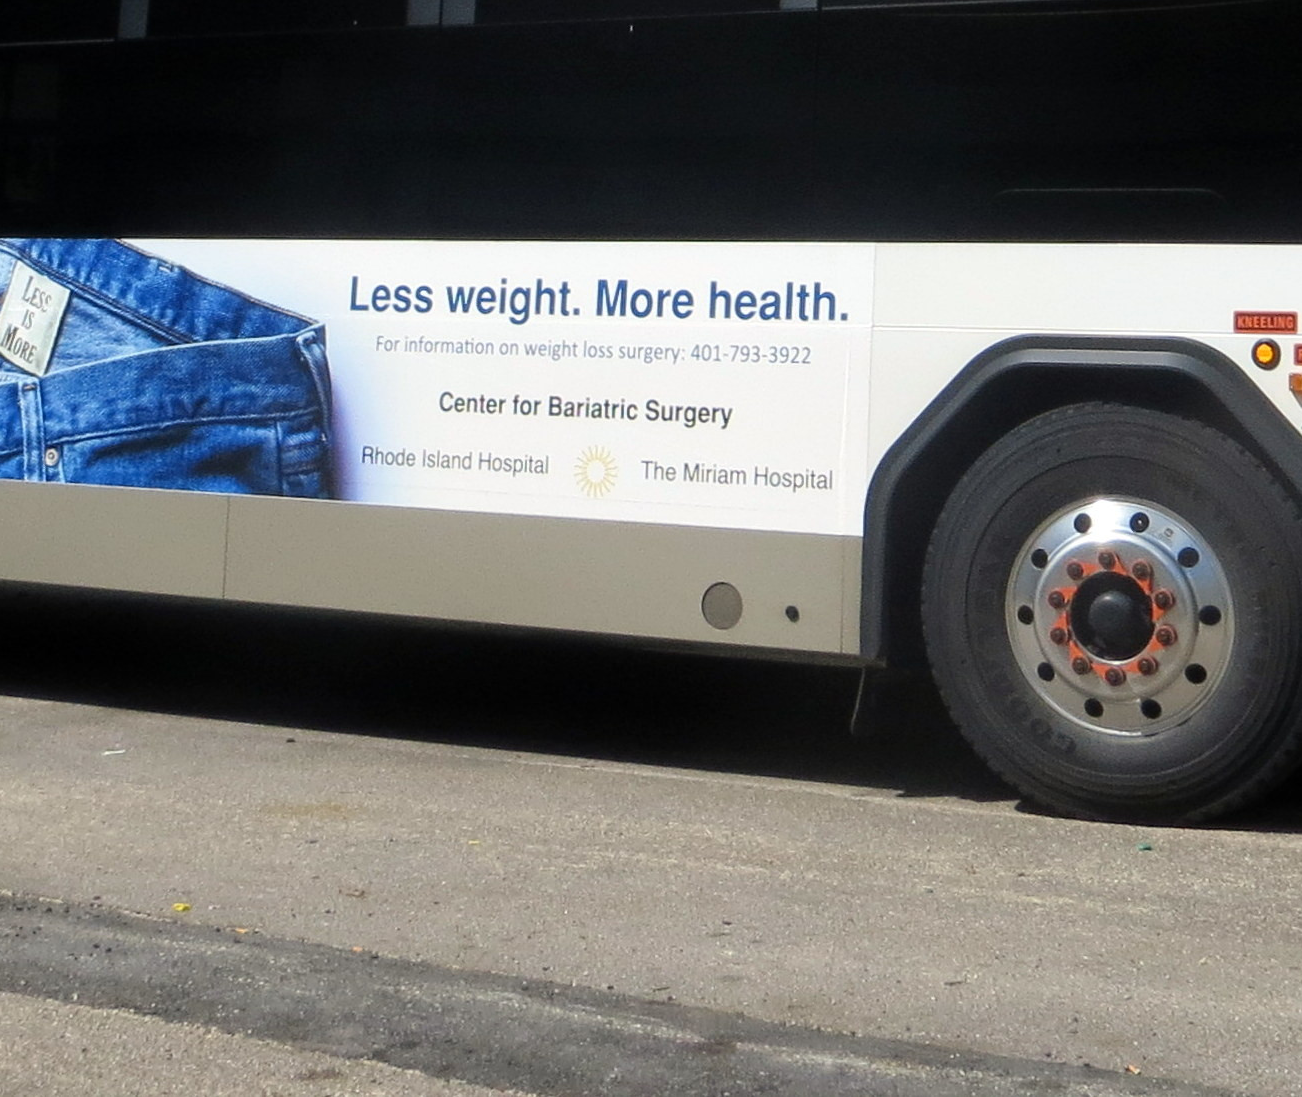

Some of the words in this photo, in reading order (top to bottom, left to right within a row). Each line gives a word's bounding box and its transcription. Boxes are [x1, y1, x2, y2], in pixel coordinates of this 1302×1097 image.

[21, 275, 53, 311] LESS
[349, 275, 434, 314] Less
[446, 277, 581, 325] weight.
[595, 279, 695, 319] More
[708, 281, 849, 322] health.
[21, 308, 35, 330] IS
[1237, 315, 1294, 329] KNEELING
[0, 322, 39, 363] MORE
[375, 335, 400, 353] For
[404, 336, 495, 357] information
[499, 342, 519, 357] on
[525, 338, 578, 361] weight
[583, 340, 614, 359] loss
[618, 344, 686, 365] surgery:
[690, 344, 812, 365] 401-793-3922
[439, 391, 505, 415] Center
[512, 394, 542, 416] for
[548, 396, 638, 421] Bariatric
[645, 401, 734, 430] Surgery
[361, 446, 416, 469] Rhode
[421, 448, 473, 471] Island
[478, 451, 550, 477] Hospital
[641, 460, 677, 483] The
[683, 462, 747, 487] Miriam
[754, 466, 834, 492] Hospital
